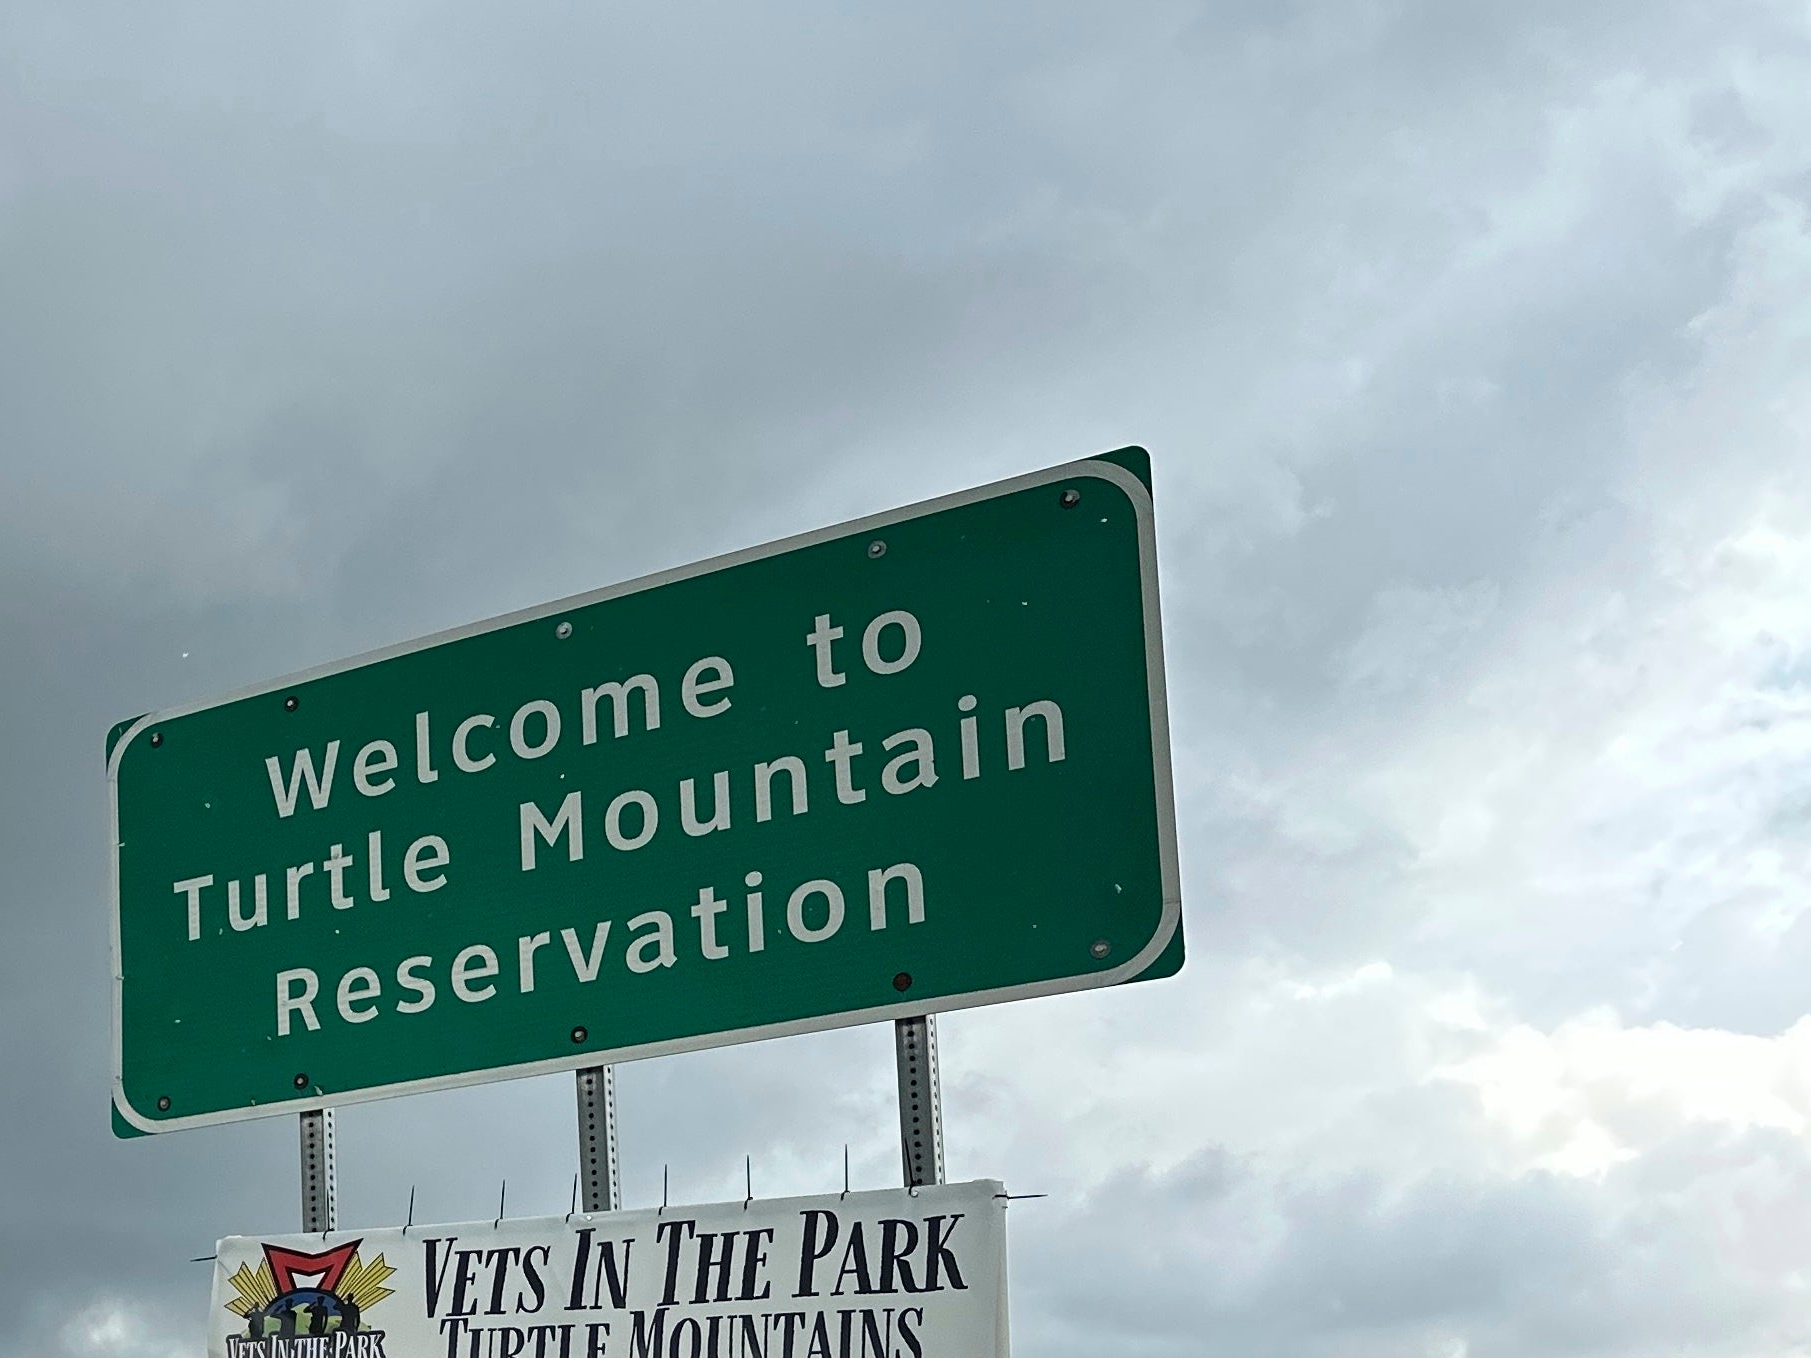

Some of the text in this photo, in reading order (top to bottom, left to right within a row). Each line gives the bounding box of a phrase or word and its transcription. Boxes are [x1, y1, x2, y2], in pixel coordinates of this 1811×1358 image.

[265, 609, 922, 818] Welcome to
[173, 695, 1066, 941] Turtle Mountain
[277, 862, 928, 1037] Reservation
[422, 1210, 968, 1318] VETS IN THE PARK
